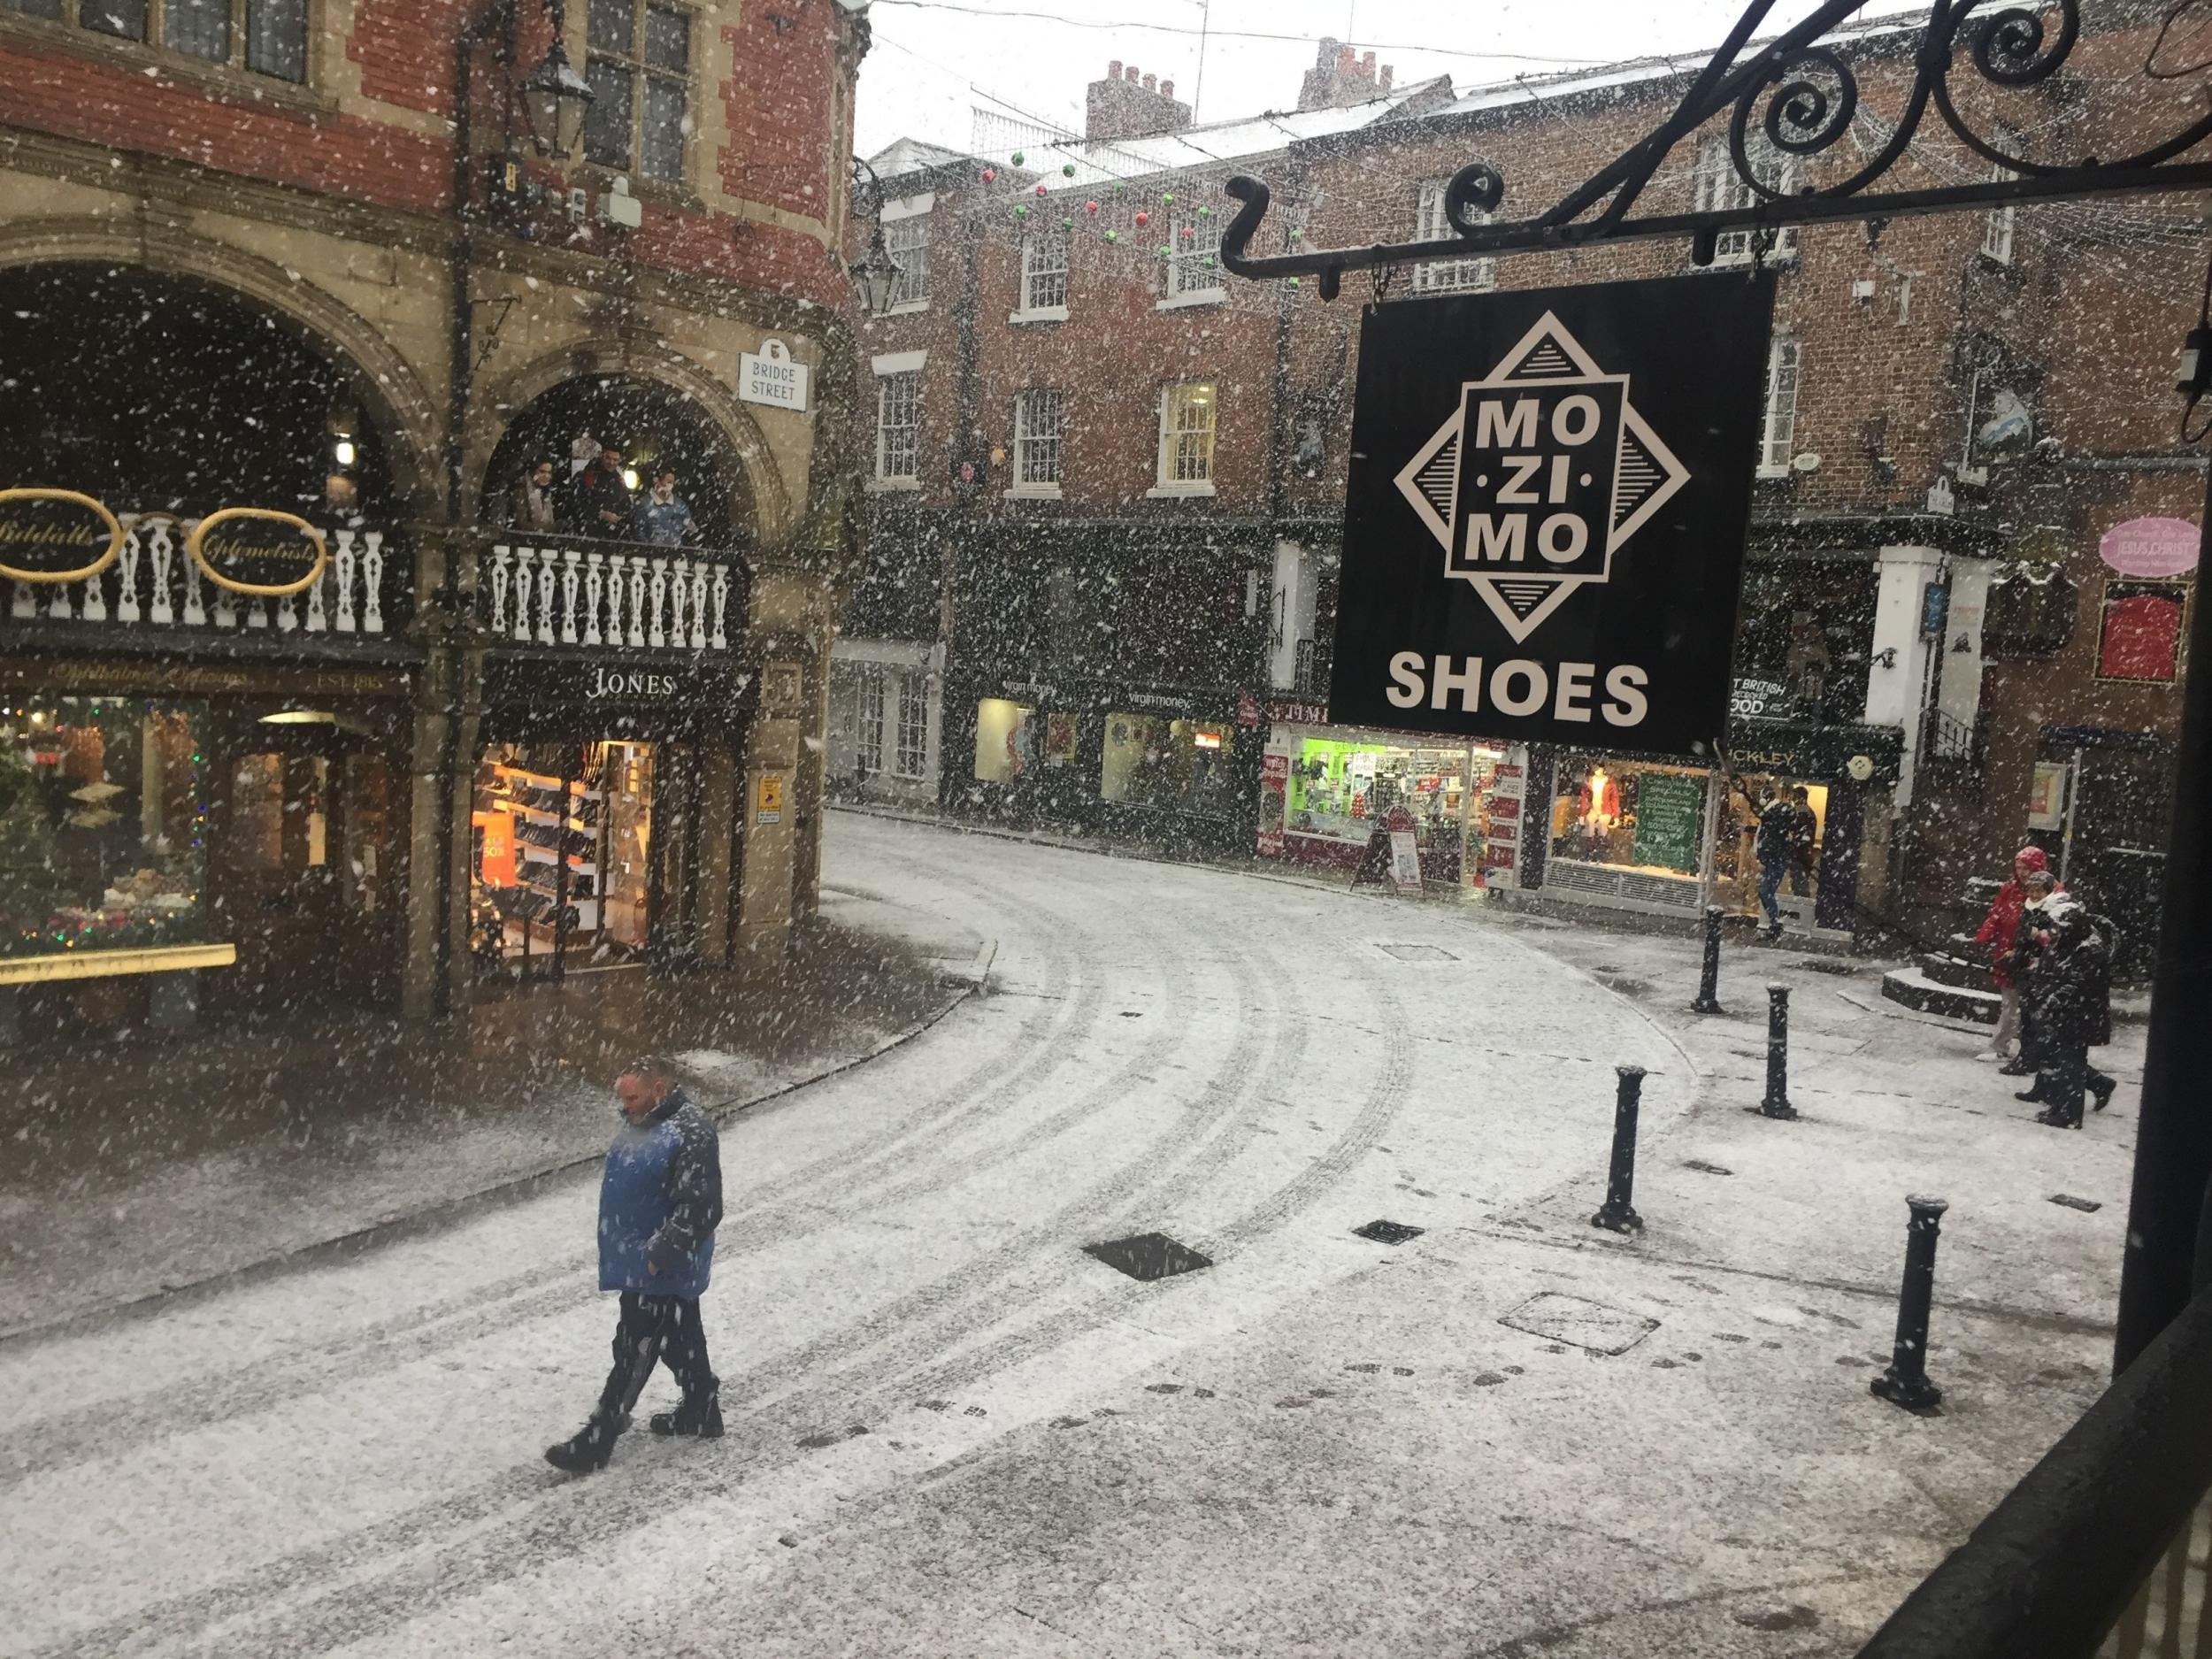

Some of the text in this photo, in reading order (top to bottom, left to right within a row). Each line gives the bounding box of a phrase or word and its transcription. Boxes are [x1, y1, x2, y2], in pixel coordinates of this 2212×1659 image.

[753, 361, 795, 383] BRIDGE
[751, 380, 795, 401] STREET
[1475, 394, 1601, 449] MO
[1464, 512, 1589, 564] MO
[2116, 540, 2191, 557] JESUS CHRIST
[585, 667, 674, 698] JONES
[1386, 650, 1648, 727] SHOES
[1741, 678, 1787, 697] BRITISH
[1128, 692, 1190, 710] virgin money
